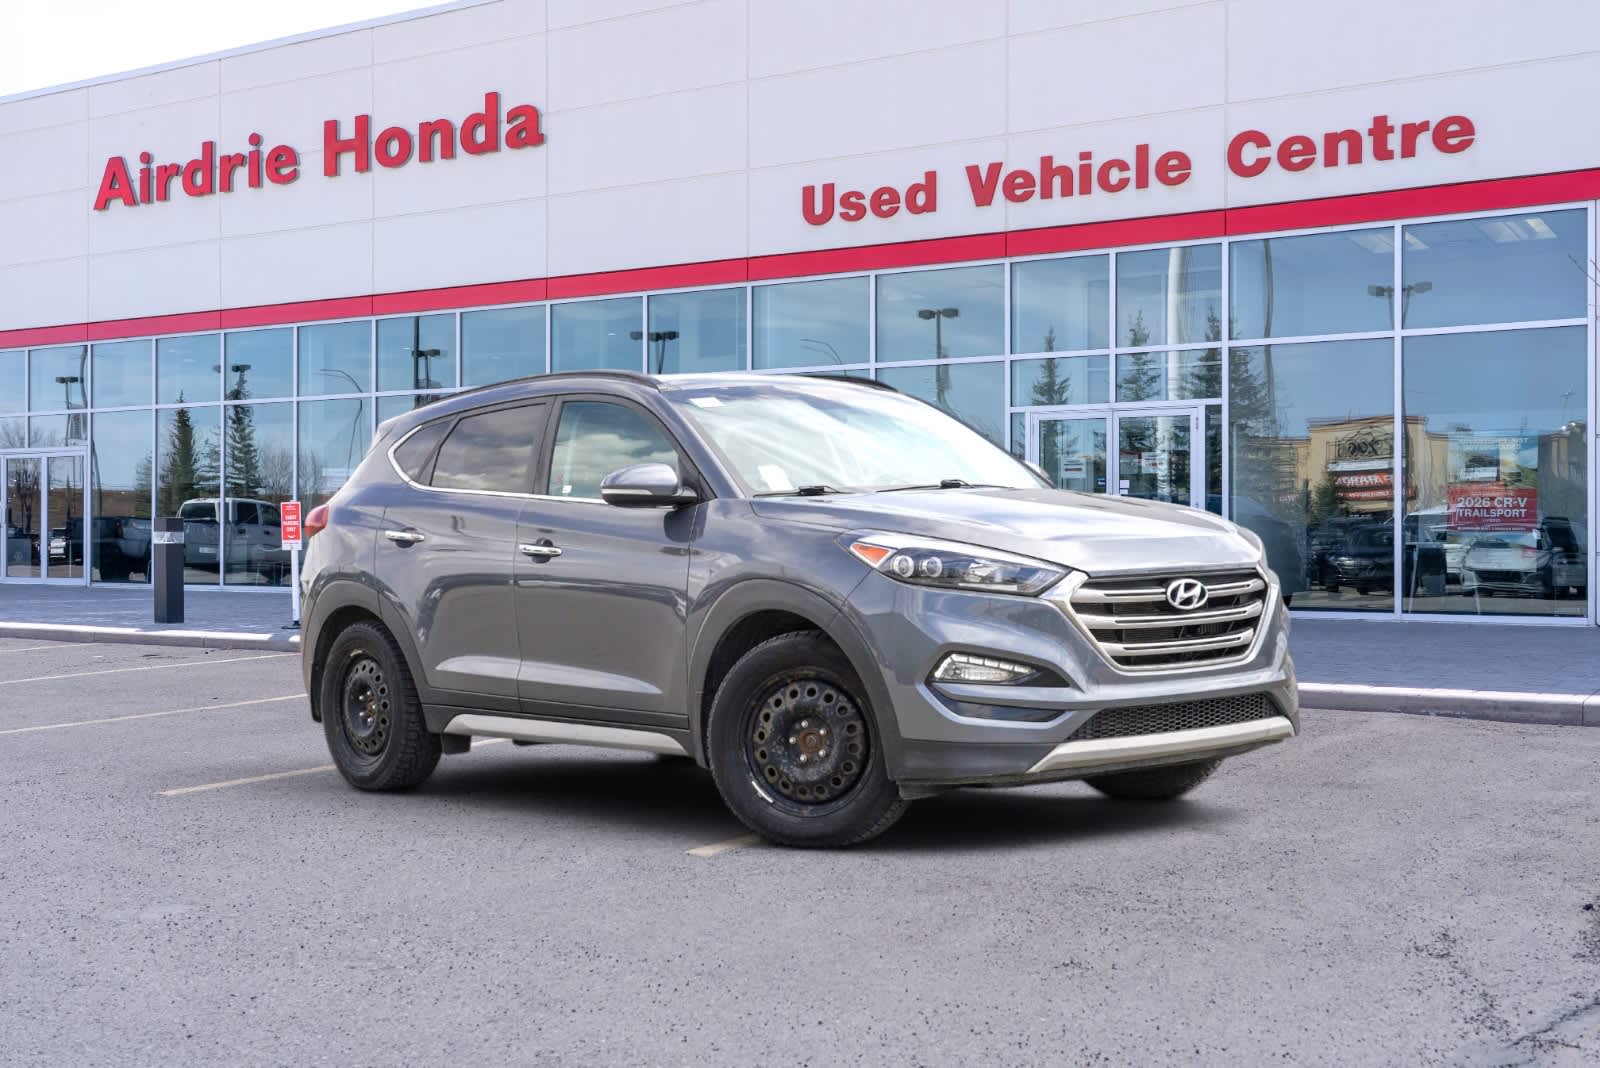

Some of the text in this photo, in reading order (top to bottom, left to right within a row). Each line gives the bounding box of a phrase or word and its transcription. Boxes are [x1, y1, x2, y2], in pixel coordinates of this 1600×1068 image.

[94, 91, 546, 210] Airdrie Honda
[802, 115, 1475, 225] Used Vehicle Centre
[1456, 497, 1528, 508] 2026 CR-V
[1458, 508, 1528, 518] TRAILSPORT
